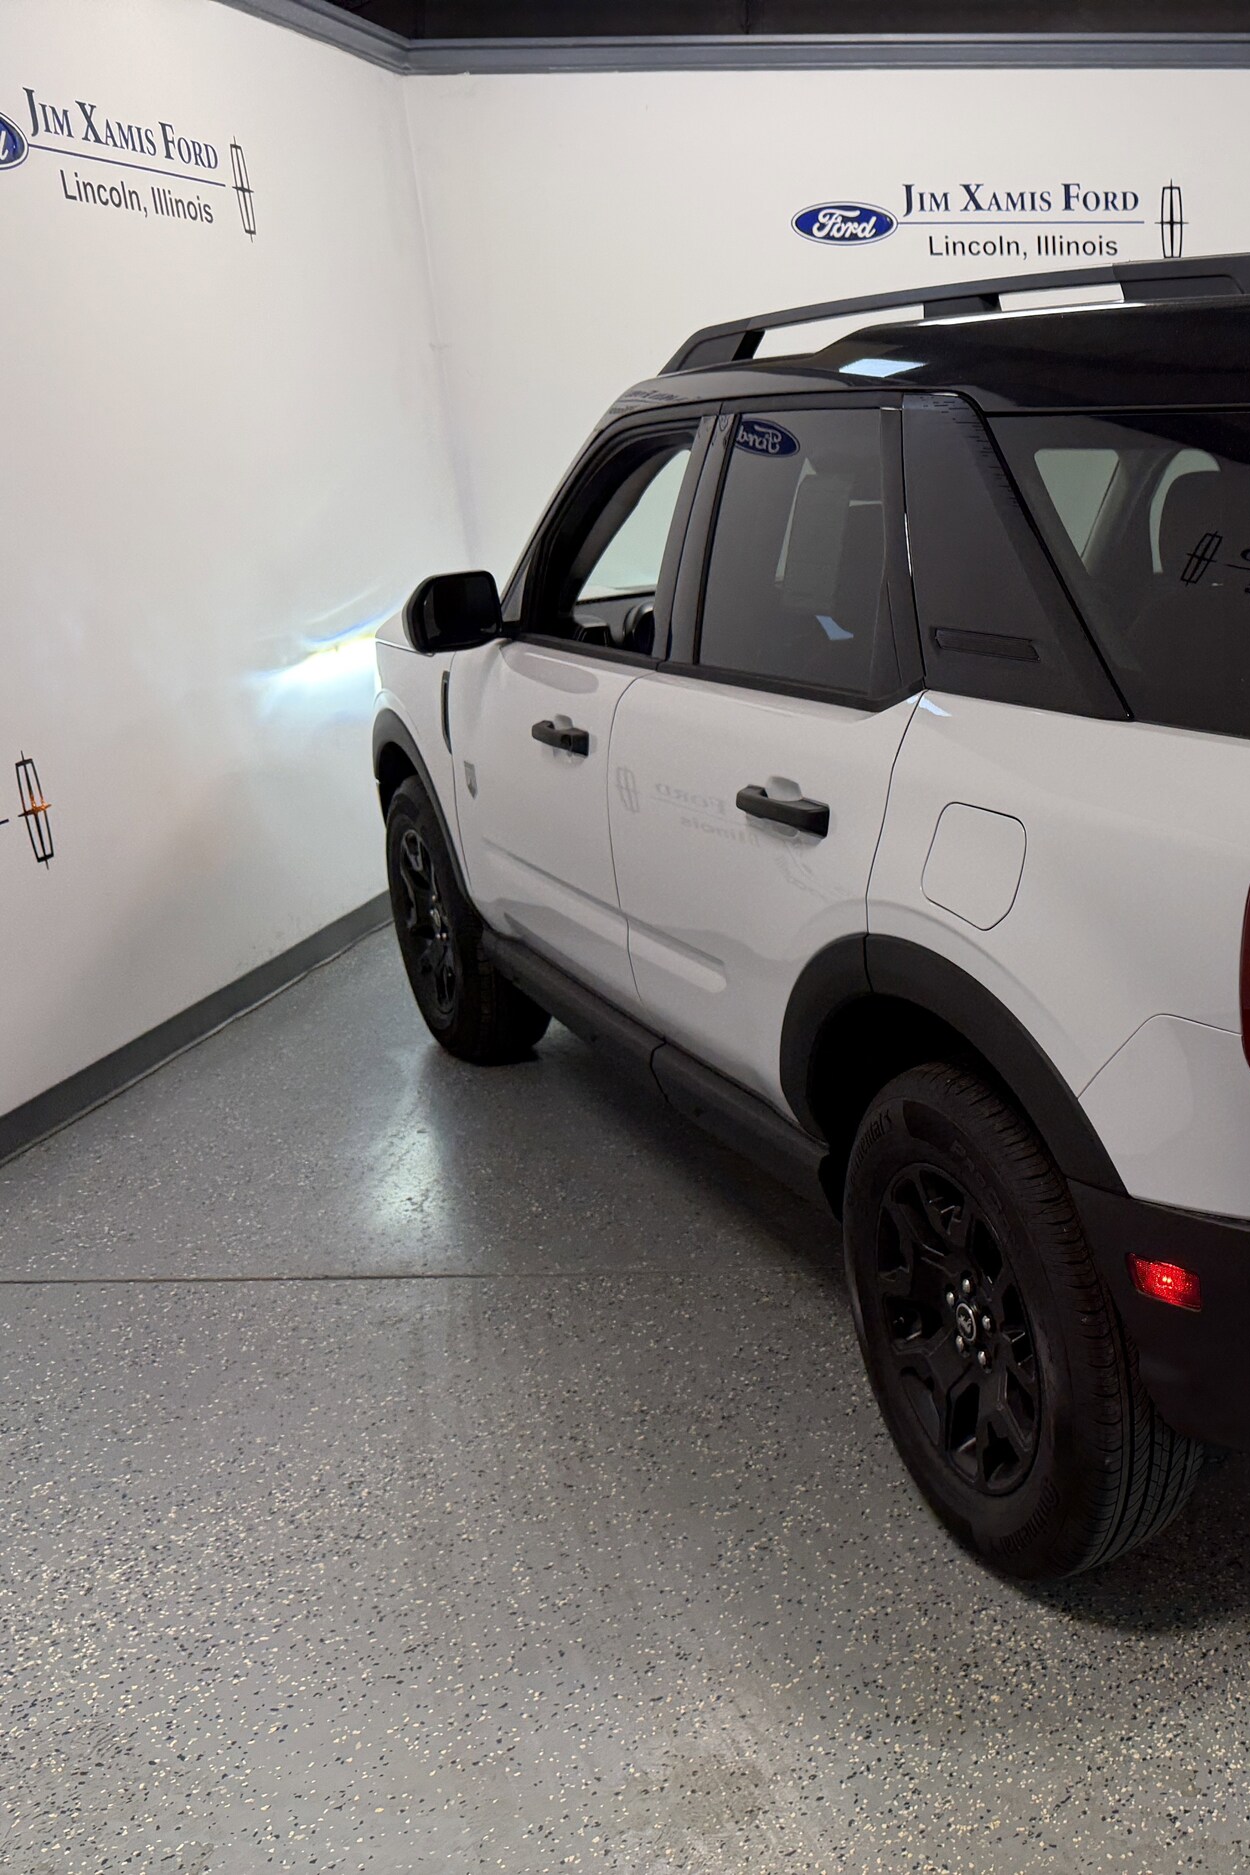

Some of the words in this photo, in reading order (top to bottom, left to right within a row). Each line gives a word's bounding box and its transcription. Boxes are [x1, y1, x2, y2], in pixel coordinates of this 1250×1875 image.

[22, 87, 74, 138] JIM
[75, 100, 157, 156] XAMIS
[158, 121, 218, 169] FORD
[60, 169, 148, 218] Lincoln,
[151, 186, 214, 224] Illinois
[902, 183, 950, 217] JIM
[959, 183, 1052, 212] XAMIS
[1061, 183, 1139, 212] FORD
[811, 209, 877, 240] Ford
[929, 235, 1028, 260] Lincoln,
[1037, 235, 1119, 256] Illinois
